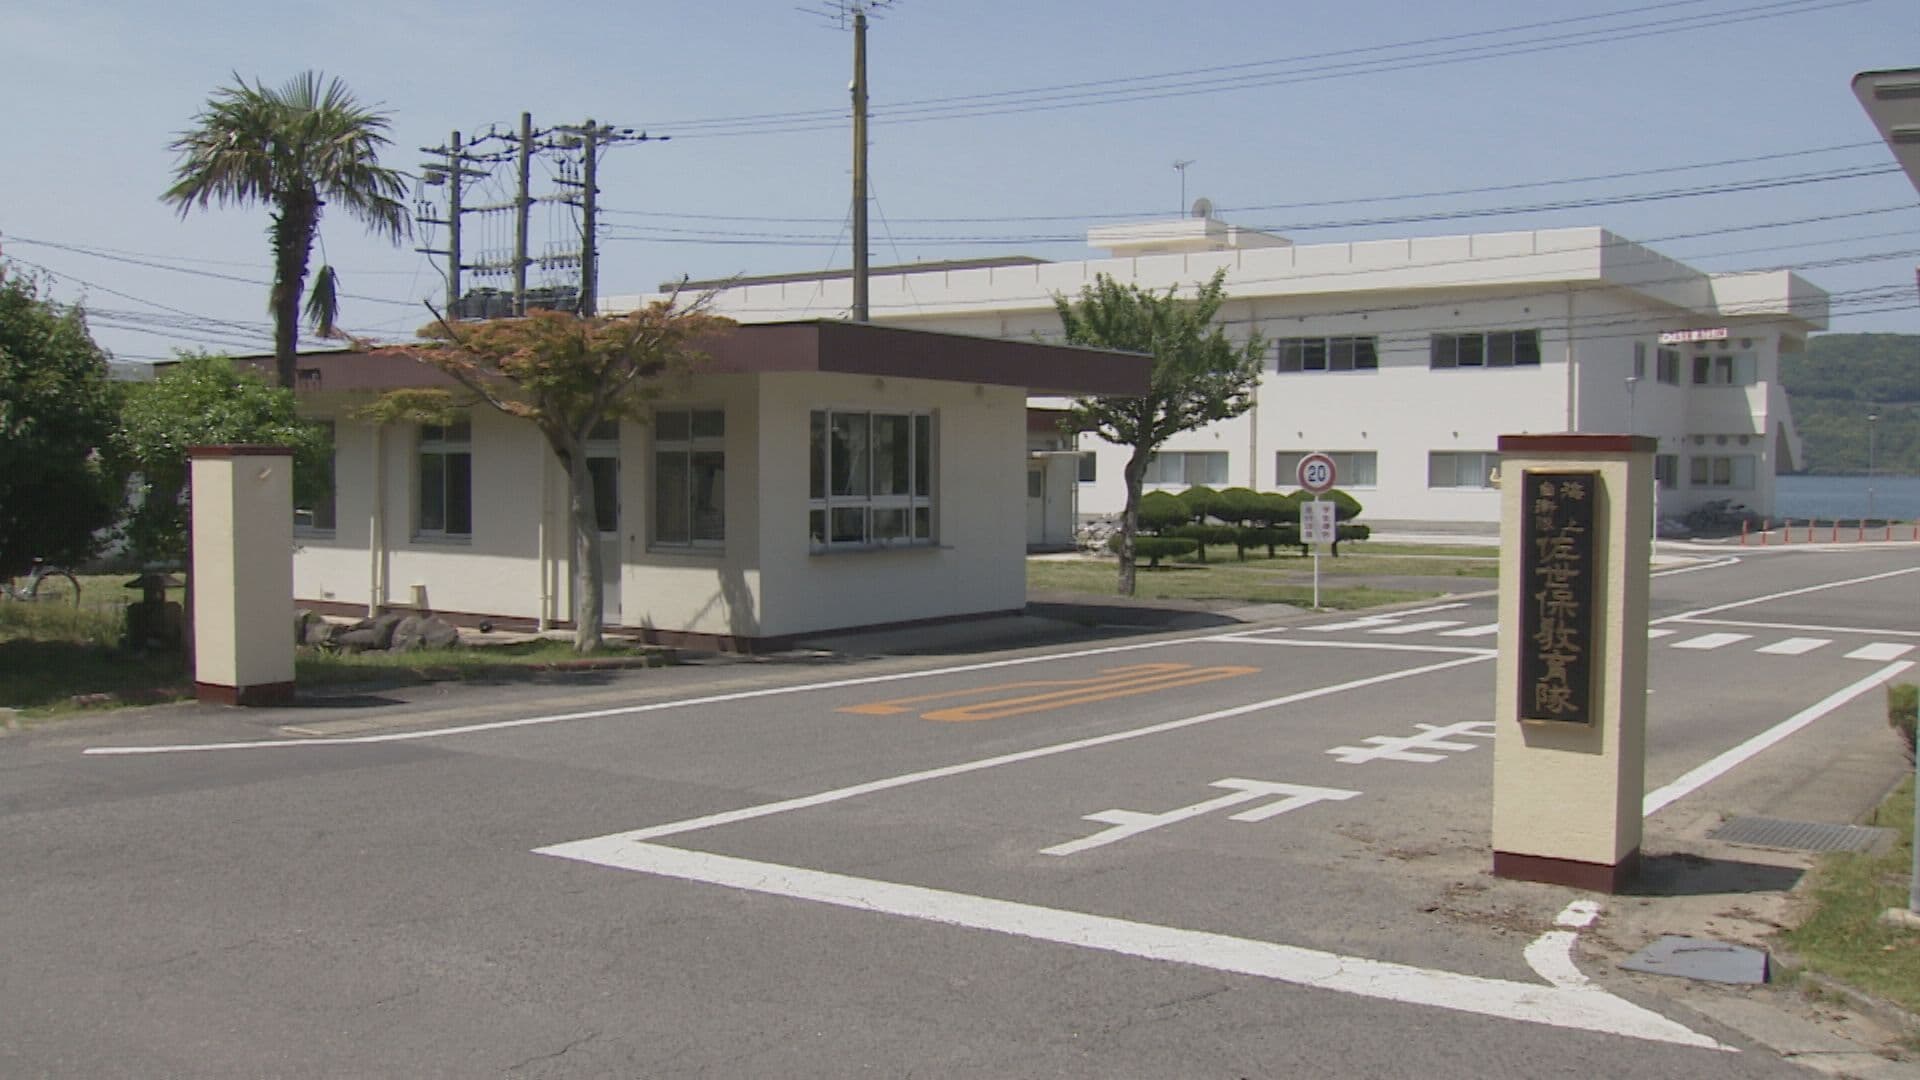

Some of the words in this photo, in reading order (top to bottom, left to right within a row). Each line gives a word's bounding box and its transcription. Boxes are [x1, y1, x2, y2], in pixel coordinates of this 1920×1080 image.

[1308, 465, 1327, 482] 20
[1533, 536, 1581, 712] 佐世保教育隊
